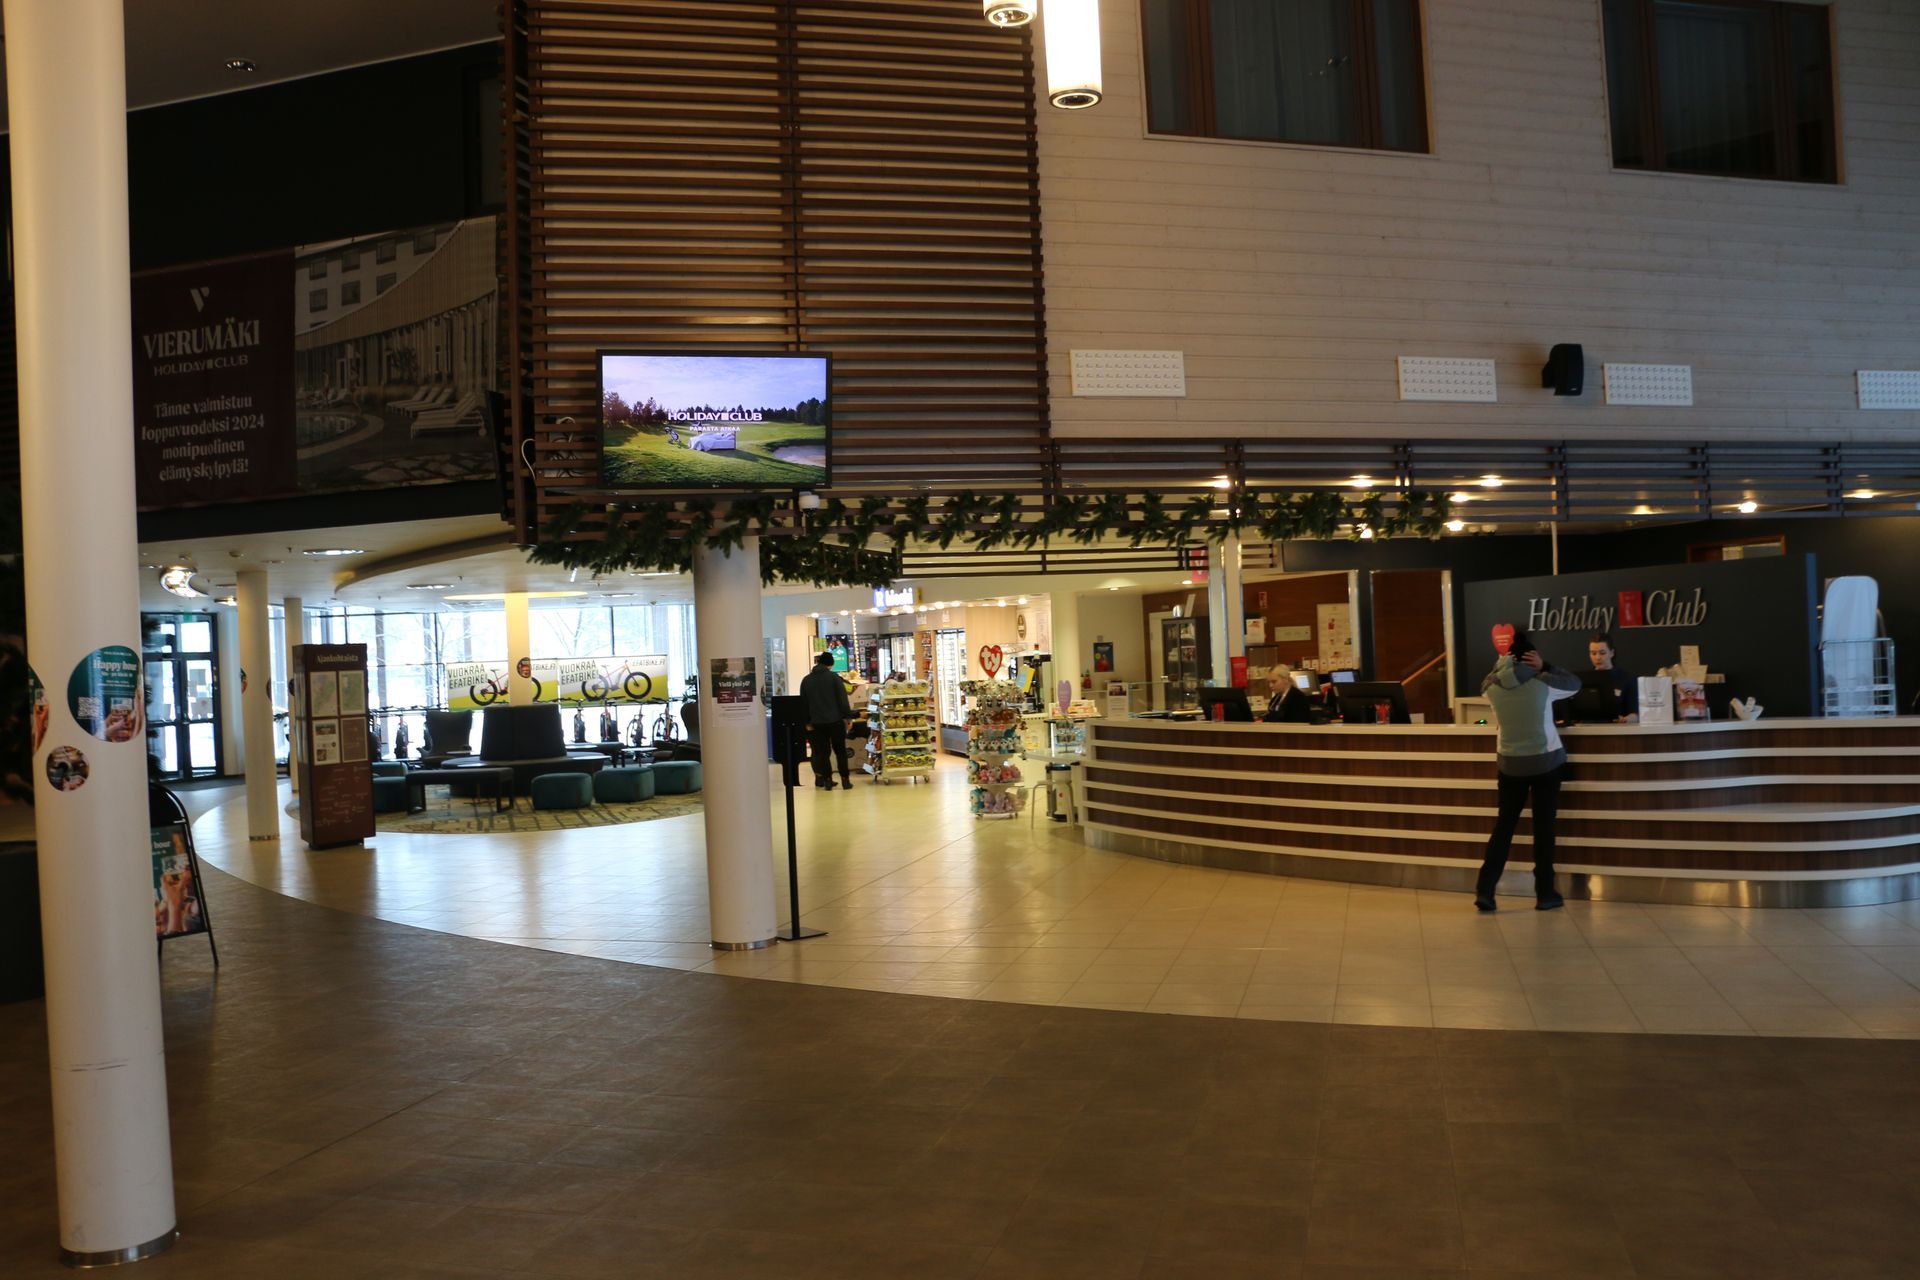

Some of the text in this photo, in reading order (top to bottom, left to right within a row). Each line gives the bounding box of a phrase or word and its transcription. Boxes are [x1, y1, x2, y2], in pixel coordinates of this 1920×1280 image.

[142, 317, 261, 360] VIERUMÄKI
[153, 354, 249, 377] HOLIDAY CLUB
[153, 395, 253, 419] Tänne valmistuu
[667, 411, 763, 421] HOLIDAY CLUB
[141, 413, 265, 444] loppuvuodeksi 2024
[162, 438, 246, 461] monipuolinen
[158, 458, 249, 483] elämyskylpylä!
[1527, 586, 1708, 634] Holiday Club
[93, 659, 121, 672] Happy
[447, 663, 486, 679] VUOKRAA
[559, 660, 597, 675] VUOKRAA
[980, 647, 1002, 673] ty
[449, 673, 488, 690] EFATBIKE!
[561, 669, 600, 685] EFATBIKE!
